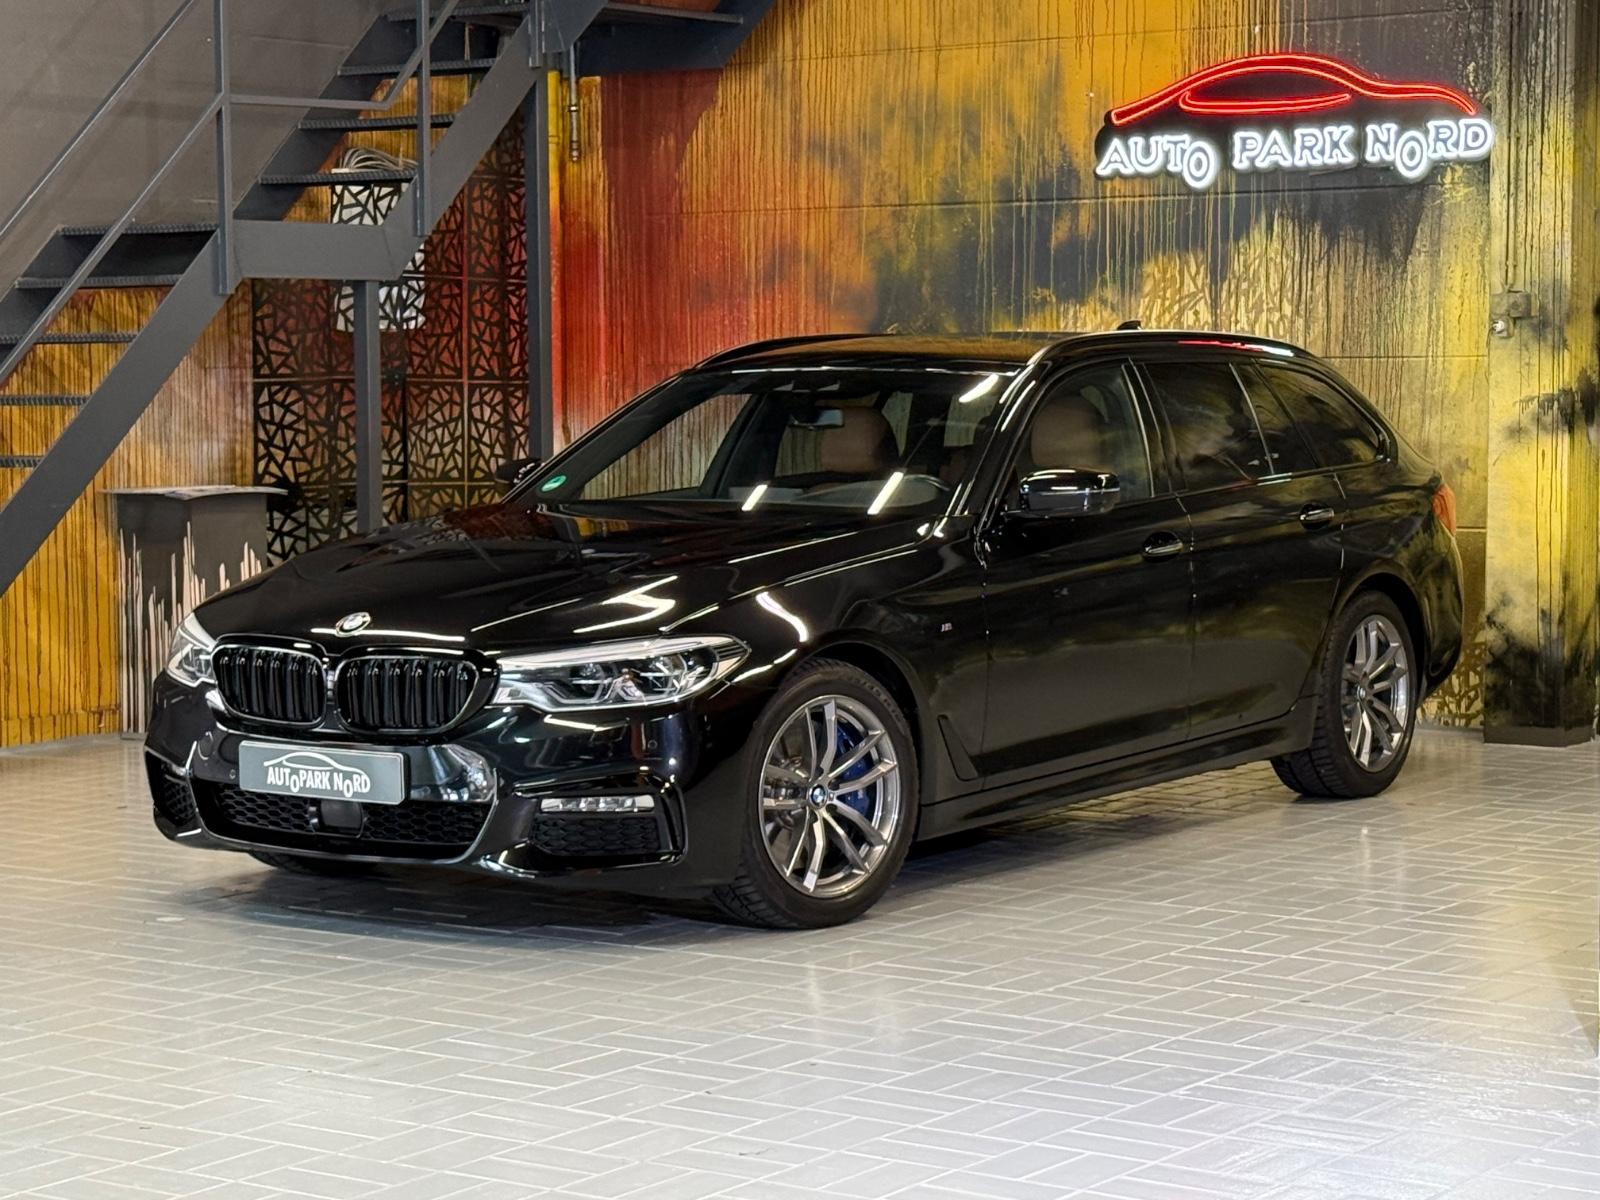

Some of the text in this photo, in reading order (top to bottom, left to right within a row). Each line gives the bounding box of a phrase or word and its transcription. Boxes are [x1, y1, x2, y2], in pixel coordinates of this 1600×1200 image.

[1096, 118, 1494, 189] AUTO PARK NORD
[333, 770, 371, 798] NORD
